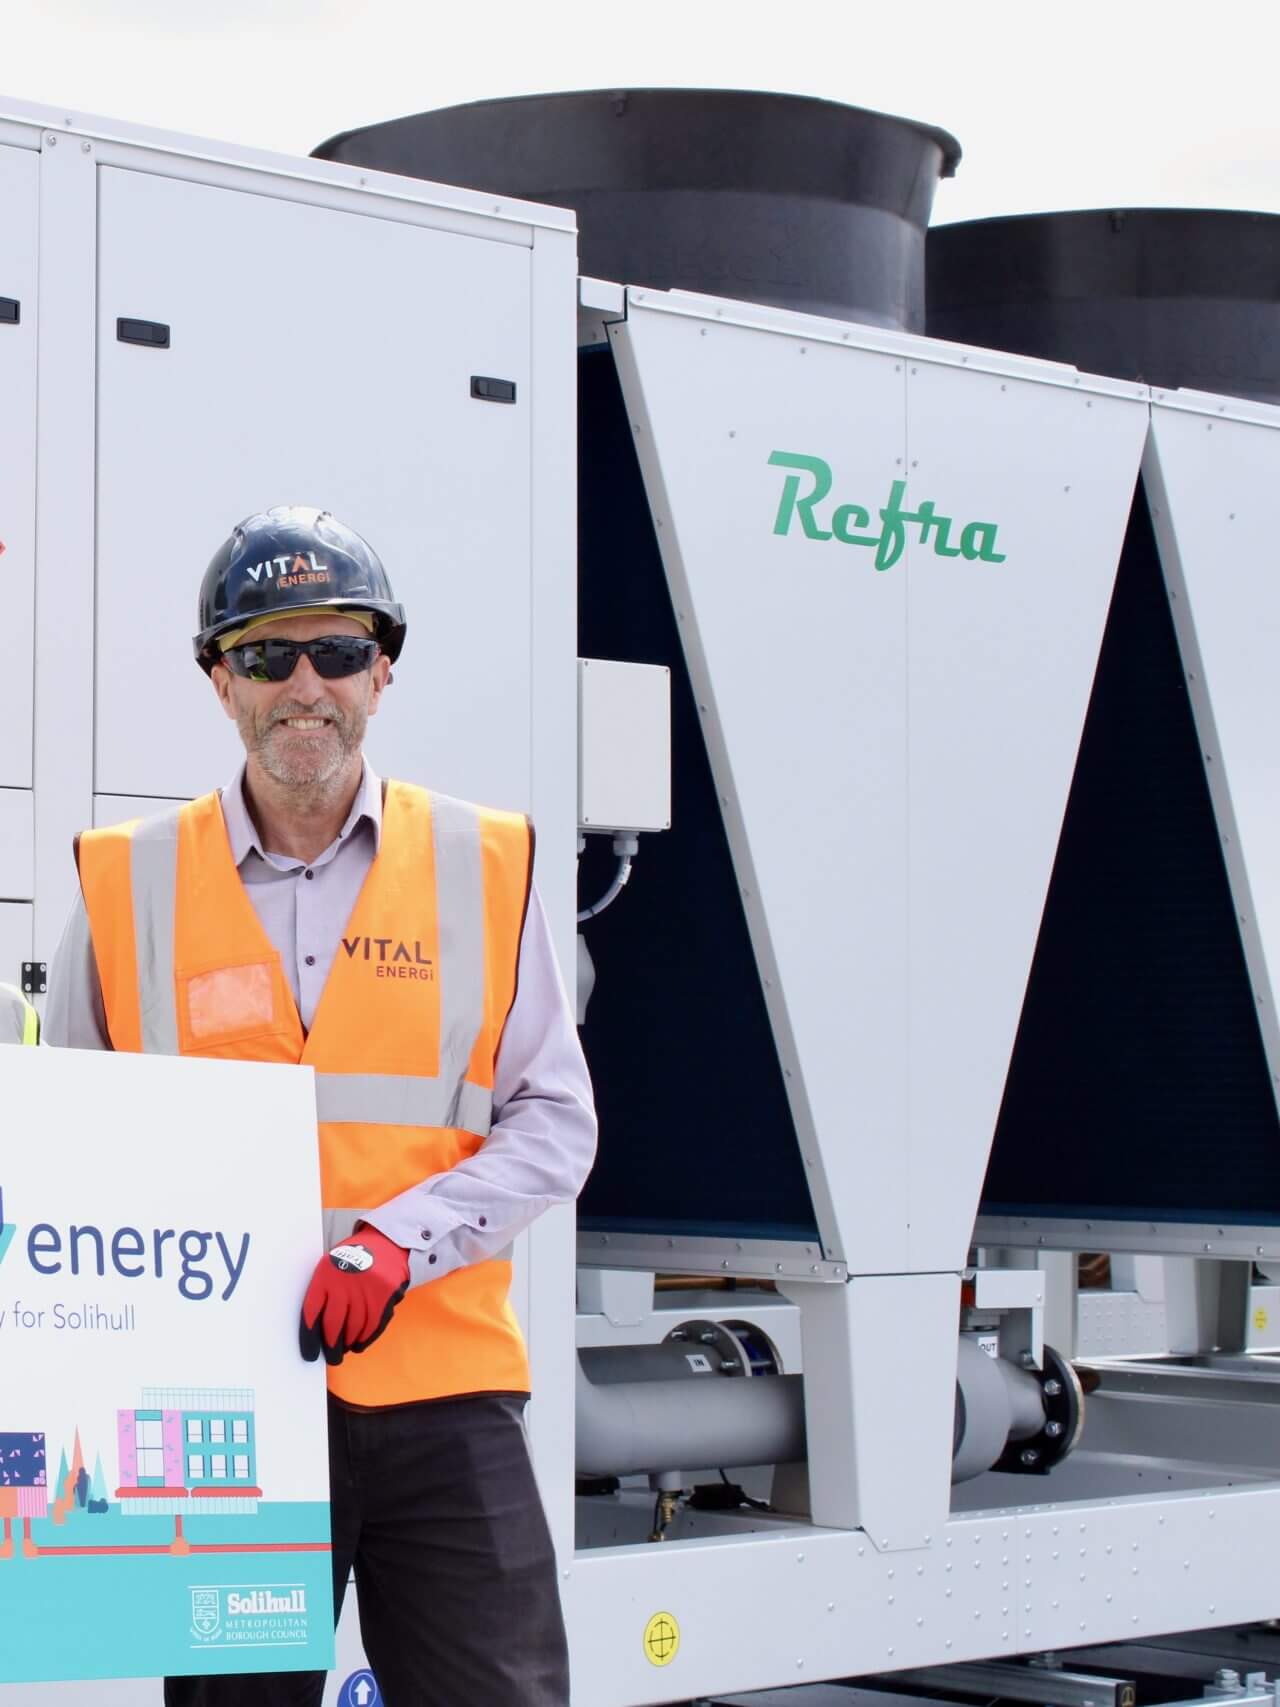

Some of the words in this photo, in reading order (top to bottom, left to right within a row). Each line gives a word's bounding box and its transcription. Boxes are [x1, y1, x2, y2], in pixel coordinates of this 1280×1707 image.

[767, 449, 1007, 572] Refra
[246, 551, 328, 582] VITAL
[341, 936, 433, 965] VITAL
[27, 1223, 251, 1301] energy
[12, 1300, 46, 1329] for
[52, 1303, 136, 1332] Solihull
[227, 1590, 307, 1615] Solihull
[225, 1618, 308, 1629] METROPOLITAN
[226, 1629, 269, 1641] BOROUGH
[271, 1628, 307, 1640] COUNCIL
